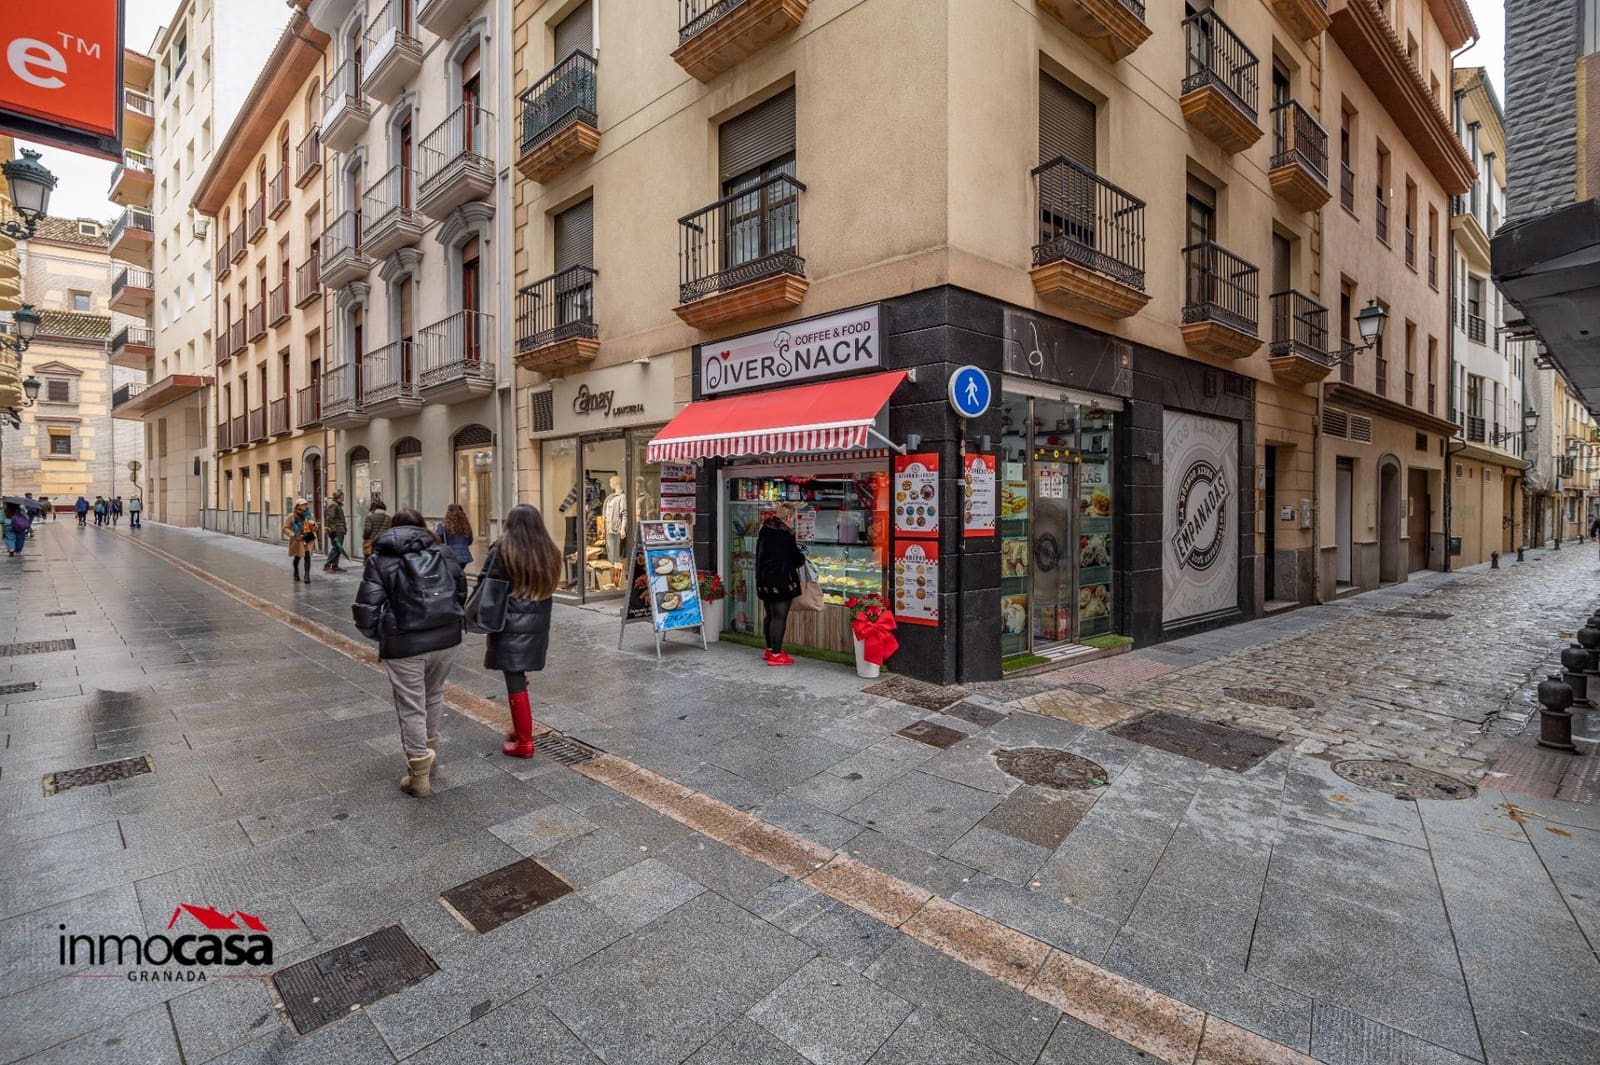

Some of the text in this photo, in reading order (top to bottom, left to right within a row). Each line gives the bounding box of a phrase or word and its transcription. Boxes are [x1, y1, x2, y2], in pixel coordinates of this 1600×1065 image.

[795, 320, 871, 346] COFFEE & FOOD
[1175, 475, 1226, 559] EMPANADAS
